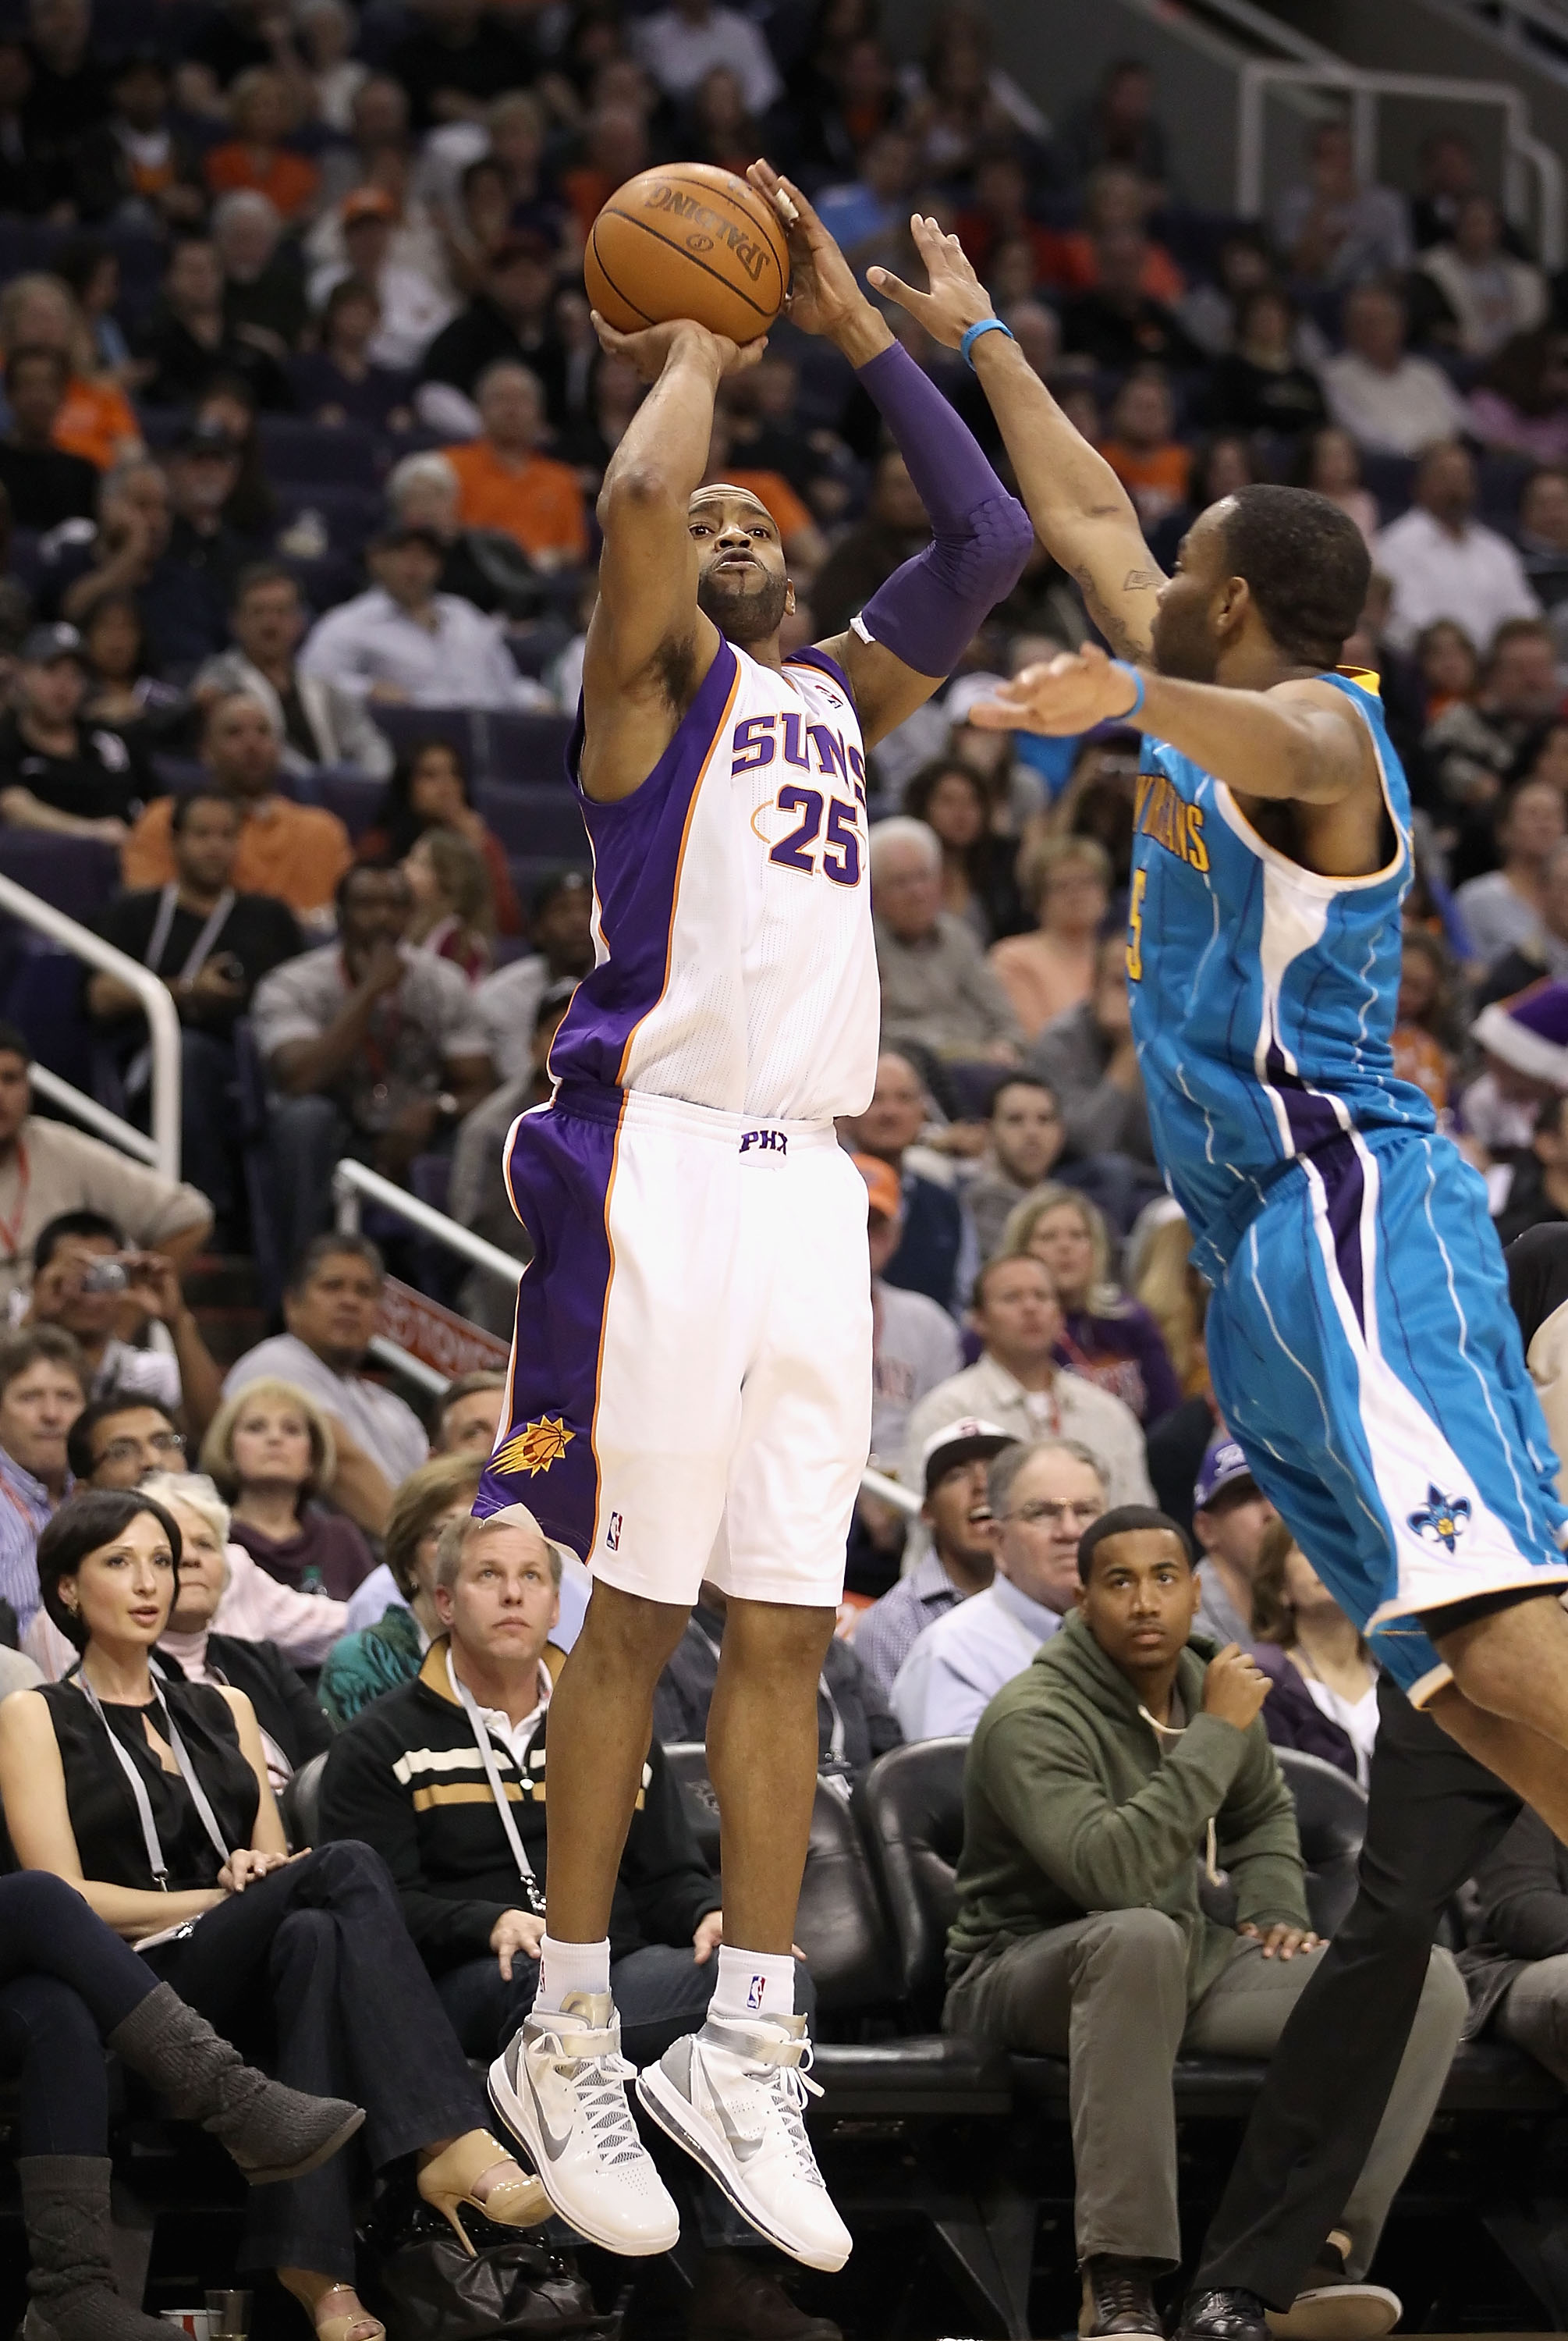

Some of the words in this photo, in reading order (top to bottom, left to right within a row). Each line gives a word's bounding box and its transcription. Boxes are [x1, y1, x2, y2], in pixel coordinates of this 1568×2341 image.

[644, 184, 770, 281] SPALDING
[731, 711, 867, 811] SUNS
[767, 783, 861, 888] 25
[739, 1129, 788, 1156] PHX
